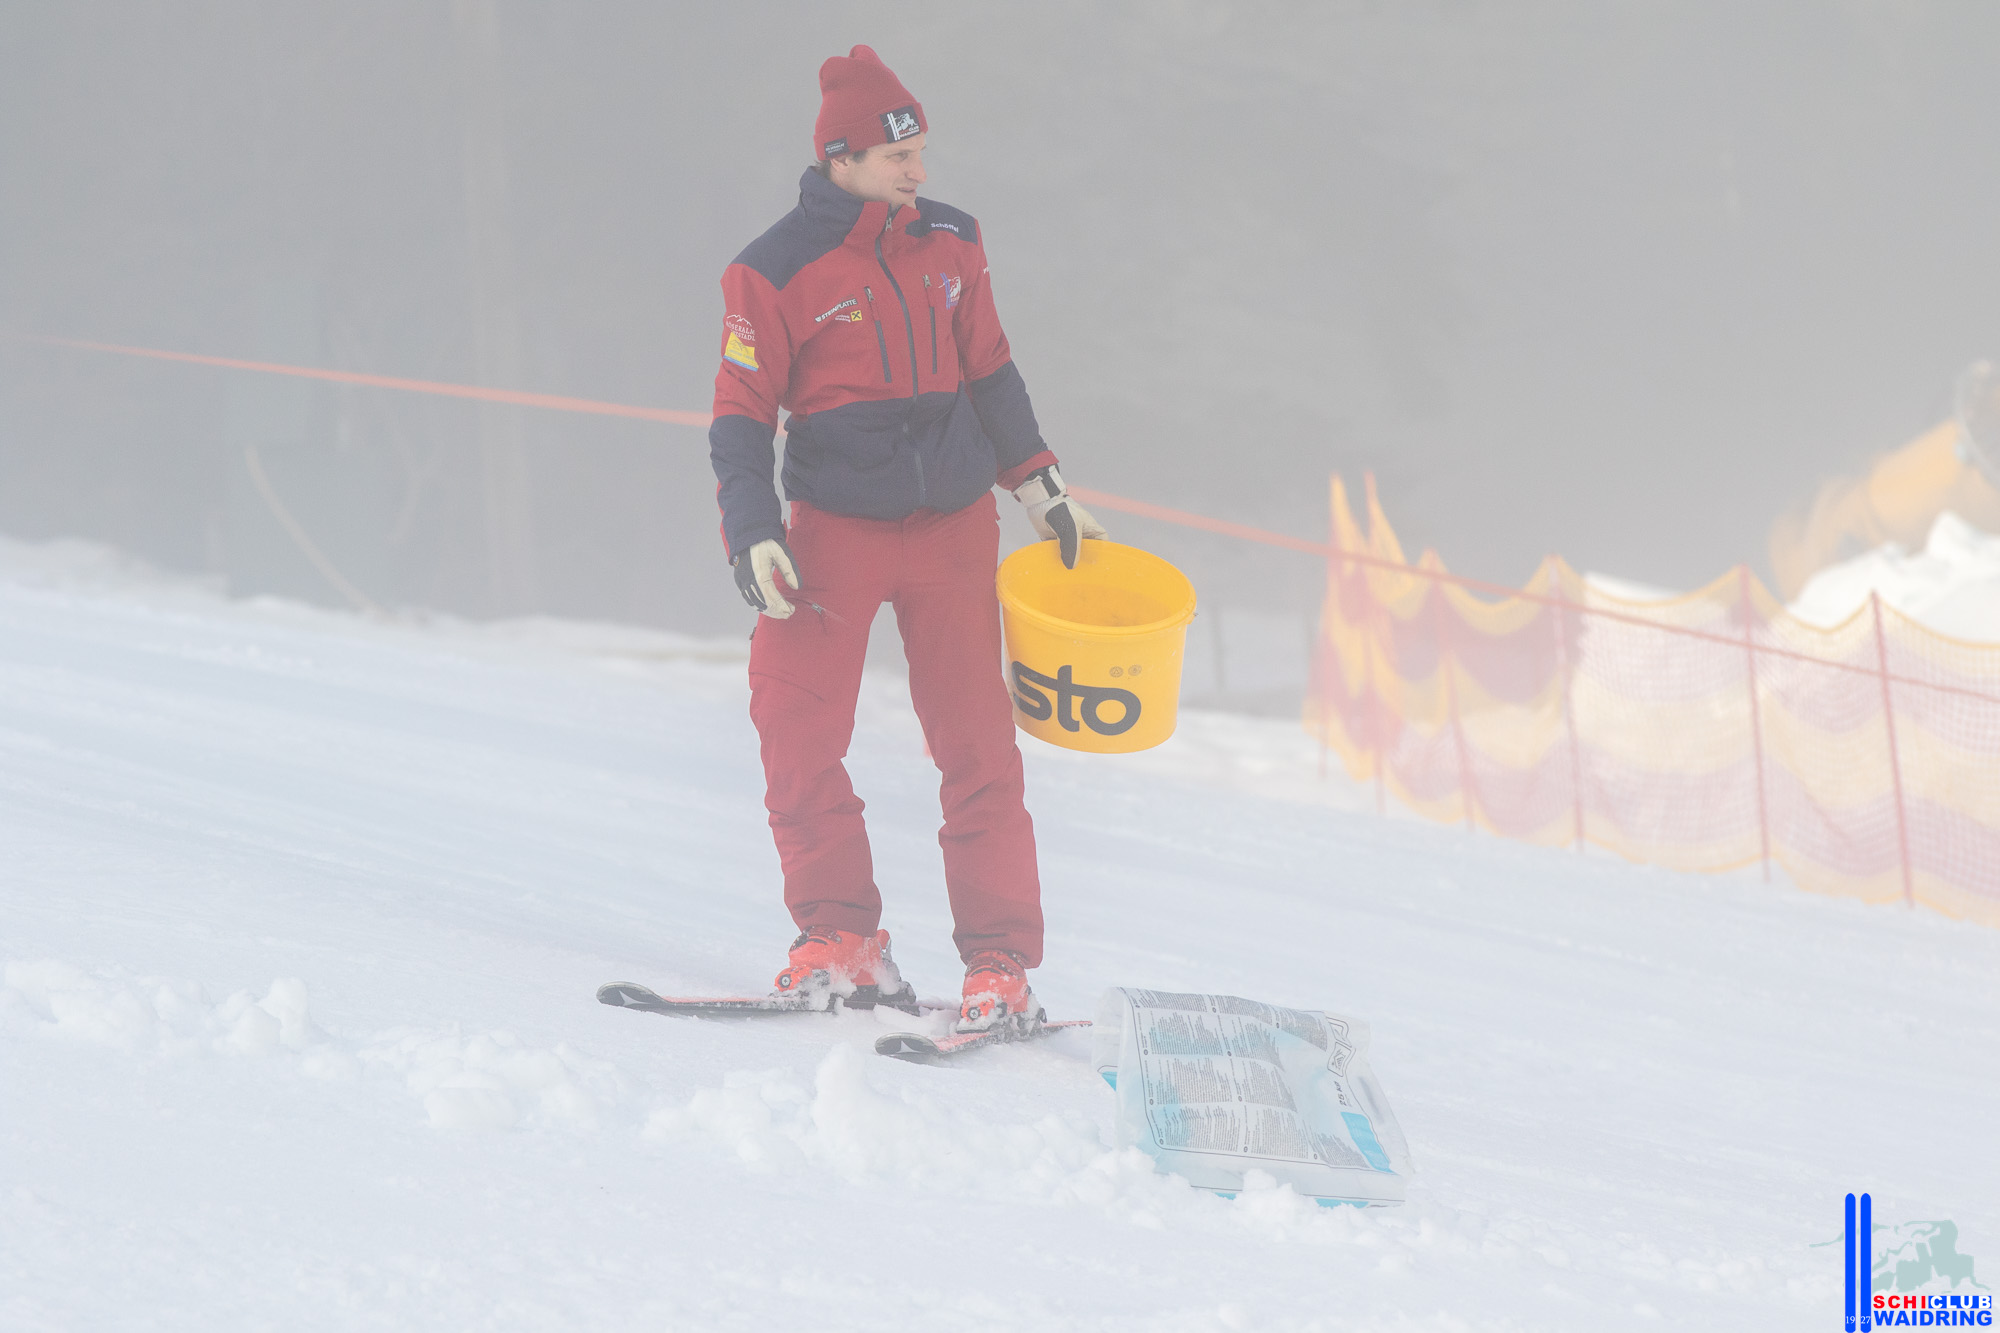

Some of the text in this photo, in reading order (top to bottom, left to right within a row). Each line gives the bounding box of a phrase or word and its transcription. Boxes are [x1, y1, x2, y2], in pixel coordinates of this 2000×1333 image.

[930, 222, 959, 233] Schöffel
[821, 298, 857, 321] STEINPLATTE
[1011, 660, 1142, 736] sto
